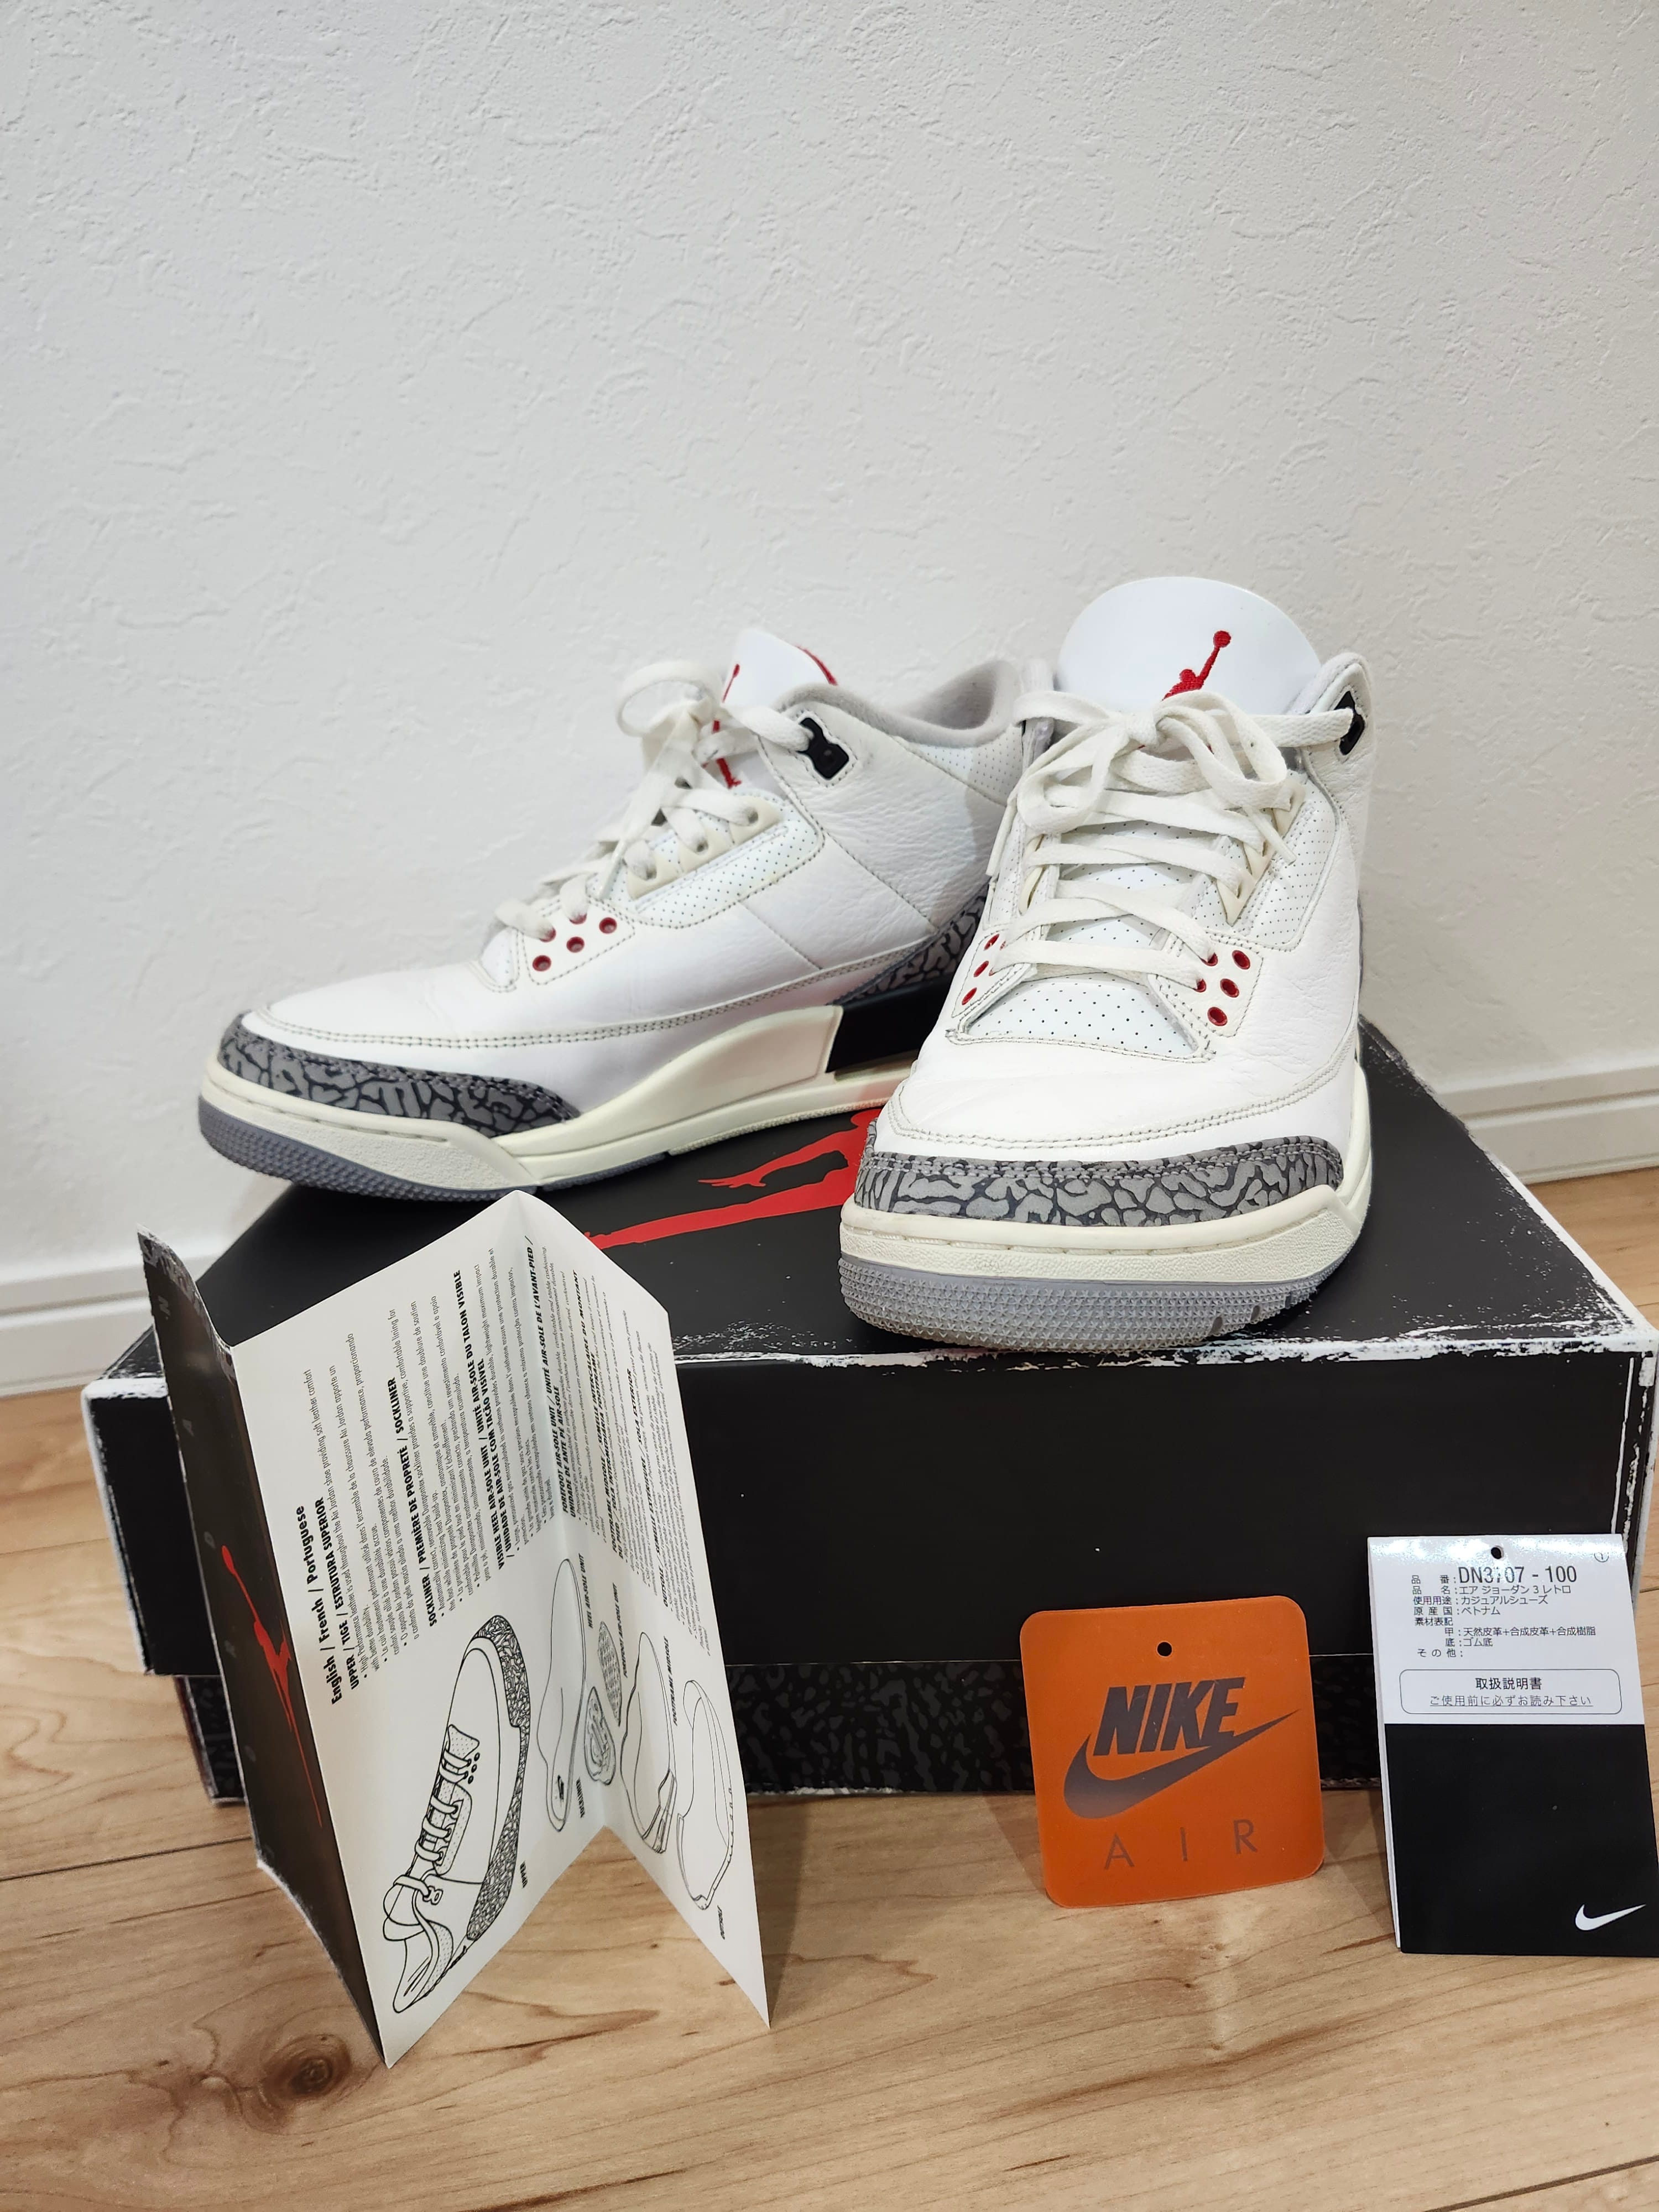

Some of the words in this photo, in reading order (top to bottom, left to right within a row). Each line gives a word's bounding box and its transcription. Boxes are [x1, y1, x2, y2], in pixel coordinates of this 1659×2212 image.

[453, 1270, 465, 1308] VISIBLE
[572, 1270, 584, 1318] MONTANT
[460, 1309, 471, 1343] TALON
[535, 1310, 543, 1323] DE
[581, 1320, 587, 1336] DU
[465, 1343, 473, 1359] DU
[538, 1325, 549, 1366] AIR-SOLE
[303, 1369, 315, 1396] comfort
[467, 1359, 480, 1402] AIR-SOLE
[477, 1358, 488, 1396] VISÍVEL
[542, 1367, 552, 1394] UNITÉ
[583, 1337, 597, 1404] INTERCALAIRE
[590, 1352, 603, 1410] FOOTFRAME
[309, 1396, 320, 1423] leather
[387, 1377, 404, 1433] SOCKLINER
[553, 1385, 564, 1426] AIR-SOLE
[627, 1368, 638, 1417] EXTERIOR
[312, 1422, 323, 1436] soft
[472, 1404, 484, 1433] UNITÉ
[548, 1405, 557, 1427] UNIT
[593, 1405, 603, 1444] SEMELLE
[634, 1419, 643, 1445] SOLA
[317, 1435, 331, 1469] providing
[480, 1444, 489, 1469] UNIT
[488, 1428, 497, 1452] COM
[552, 1428, 562, 1468] AIR-SOLE
[560, 1439, 569, 1464] ANTE
[324, 1468, 333, 1486] shoe
[397, 1445, 415, 1498] PROPRETÉ
[492, 1453, 503, 1494] AIR-SOLE
[564, 1464, 571, 1478] DE
[600, 1455, 611, 1498] MIDSOLE
[327, 1485, 337, 1510] Jordan
[408, 1497, 418, 1513] DE
[484, 1468, 496, 1510] AIR-SOLE
[498, 1494, 505, 1510] DE
[557, 1469, 568, 1513] FOREFOOT
[565, 1478, 576, 1517] UNIDADE
[315, 1497, 332, 1550] SUPERIOR
[331, 1509, 340, 1521] Air
[333, 1520, 342, 1533] the
[491, 1510, 500, 1535] HEEL
[500, 1509, 512, 1552] UNIDADE
[606, 1499, 617, 1553] FOOTFRAME
[296, 1506, 317, 1584] Portuguese
[336, 1532, 348, 1570] throughout
[411, 1512, 426, 1563] PREMIÈRE
[494, 1533, 505, 1569] VISIBLE
[617, 1544, 624, 1559] DU
[650, 1514, 661, 1556] SEMELLE
[325, 1551, 343, 1609] ESTRUTURA
[341, 1568, 352, 1586] used
[346, 1584, 353, 1594] is
[658, 1566, 668, 1607] OUTSOLE
[1545, 1566, 1577, 1582] 100
[347, 1592, 358, 1618] leather
[422, 1574, 437, 1626] SOCKLINER
[311, 1598, 330, 1643] French
[338, 1619, 351, 1645] TIGE
[353, 1615, 365, 1657] Performance
[1415, 1617, 1453, 1626] 素材表記
[323, 1655, 342, 1704] English
[346, 1654, 359, 1689] UPPER
[358, 1653, 369, 1673] High
[1430, 1695, 1592, 1707] ご使用前に必ずお読み下さい
[1475, 1677, 1542, 1690] 取扱説明書
[1093, 1677, 1245, 1756] NIKE
